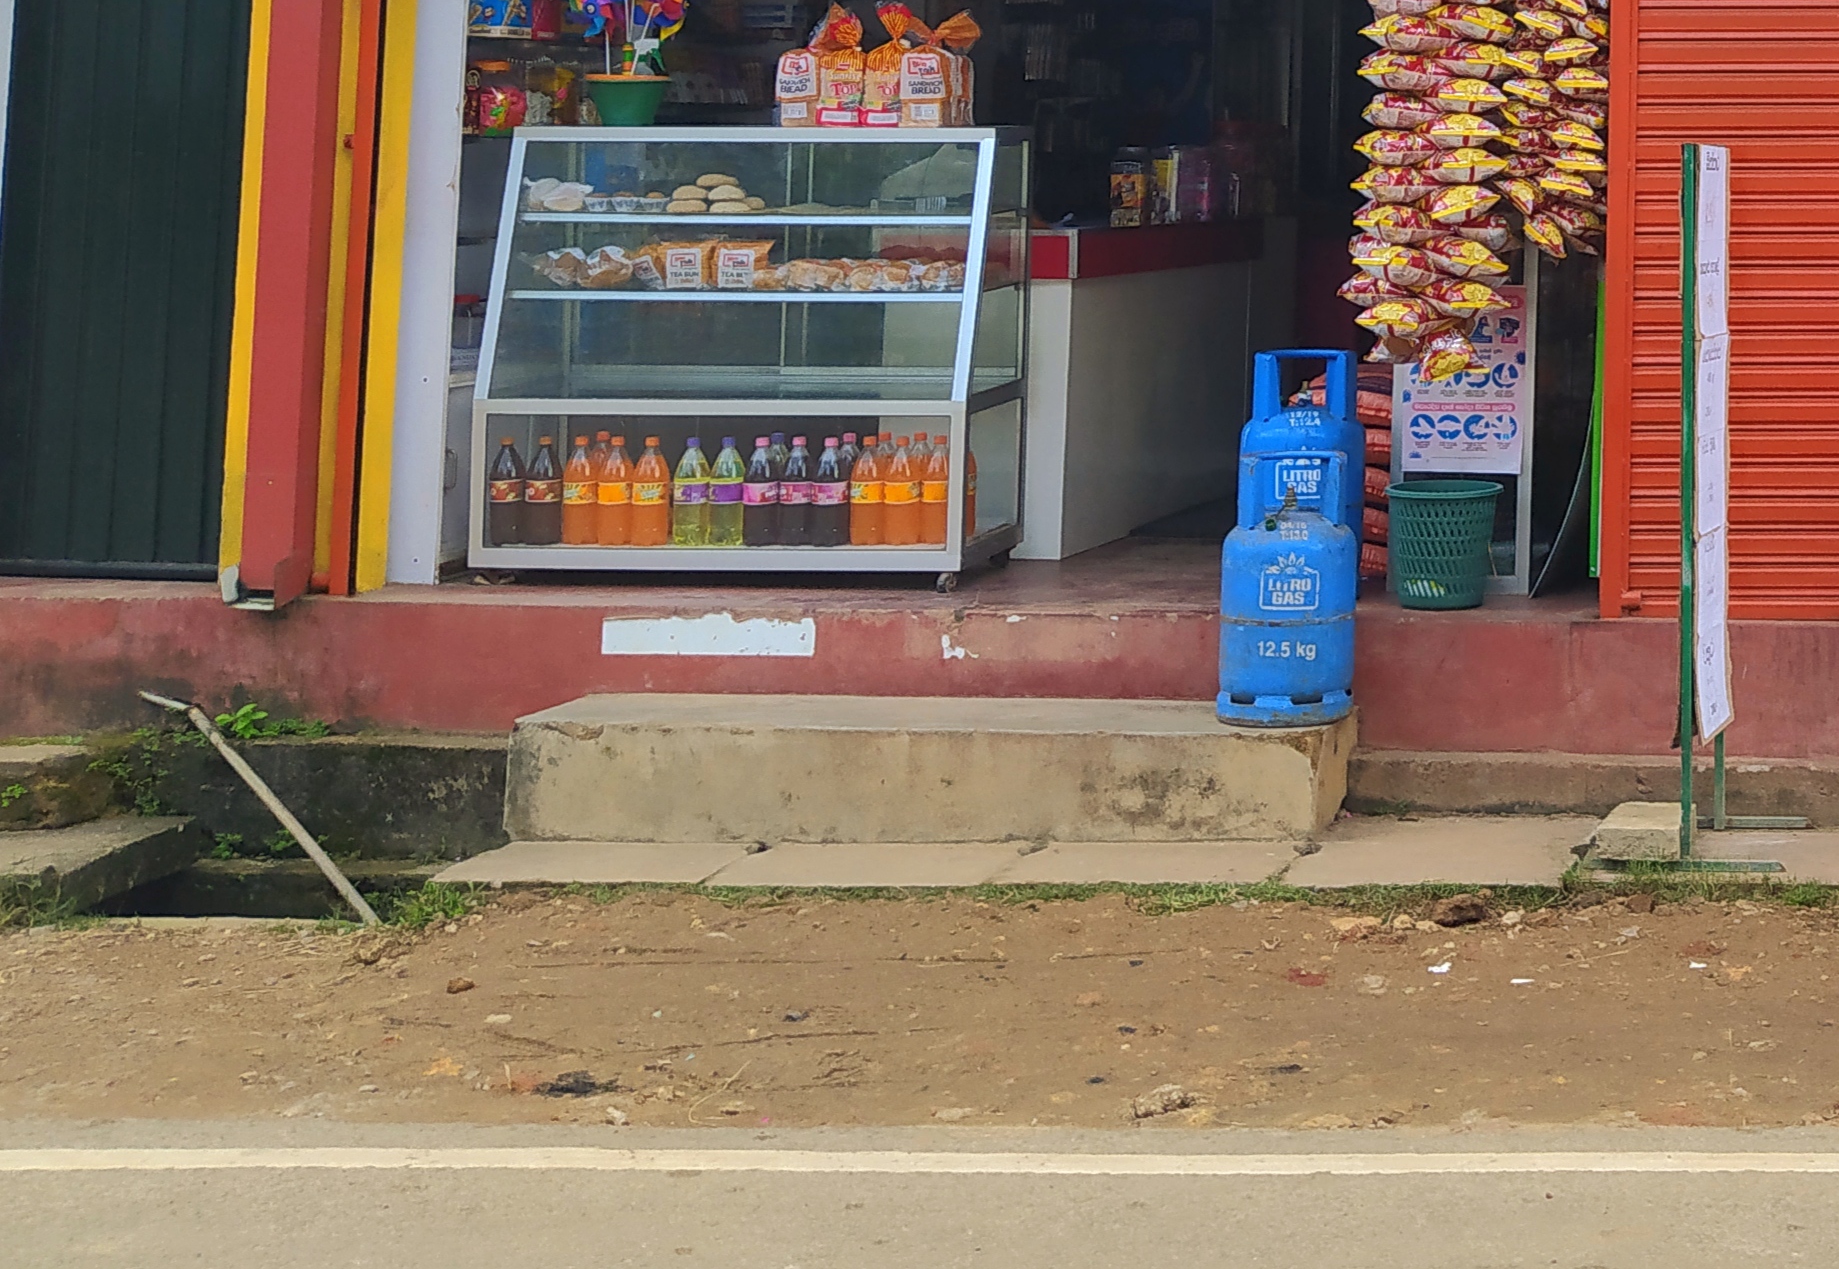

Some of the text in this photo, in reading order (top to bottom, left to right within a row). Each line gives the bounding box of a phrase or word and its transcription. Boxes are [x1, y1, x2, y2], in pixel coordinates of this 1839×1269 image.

[780, 84, 808, 93] BREAD
[911, 86, 941, 95] BREAD
[1282, 468, 1321, 482] LITRO
[1287, 481, 1318, 494] GAS
[1268, 578, 1312, 591] LITRO
[1272, 591, 1305, 605] GAS
[1257, 641, 1317, 661] 12.5 kg
